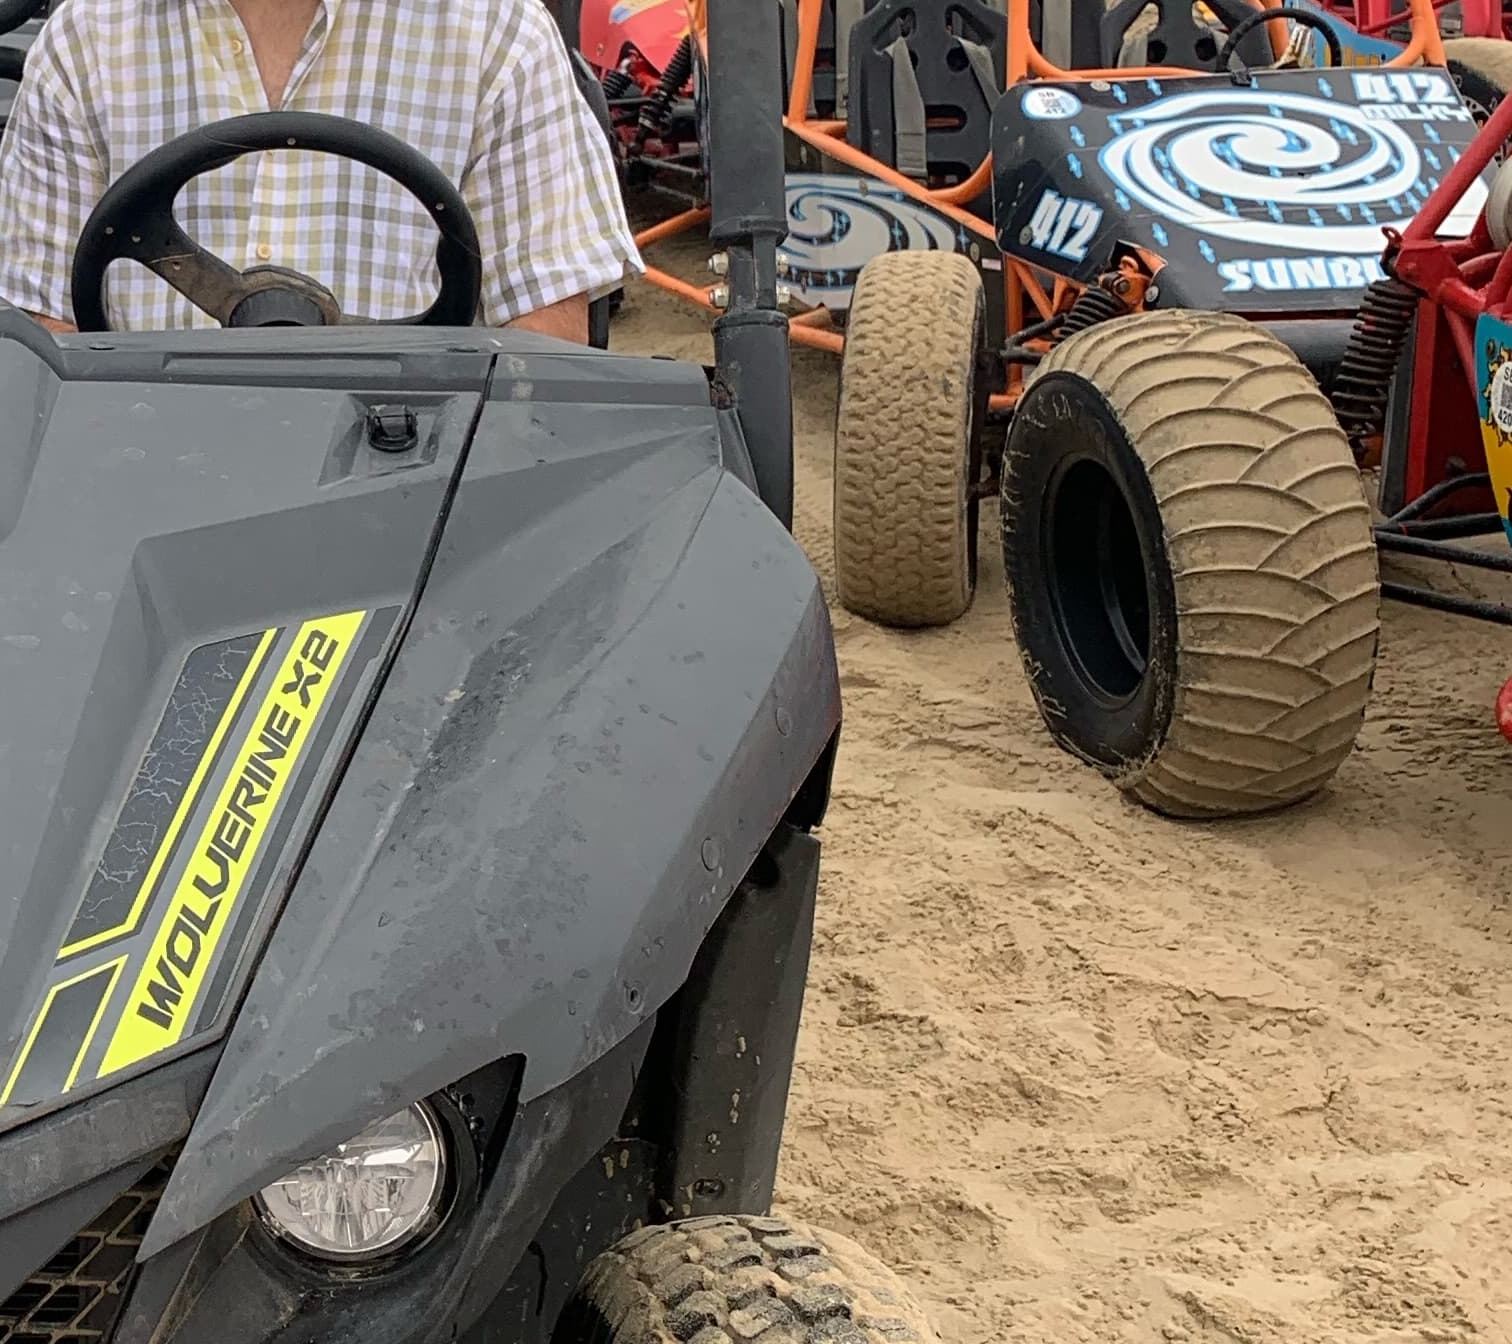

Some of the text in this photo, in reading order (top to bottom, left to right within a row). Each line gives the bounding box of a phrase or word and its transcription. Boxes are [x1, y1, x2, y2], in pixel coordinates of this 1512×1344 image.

[1351, 72, 1458, 104] 412
[1030, 188, 1105, 264] 412
[136, 628, 338, 1031] WOLVERINE X2
